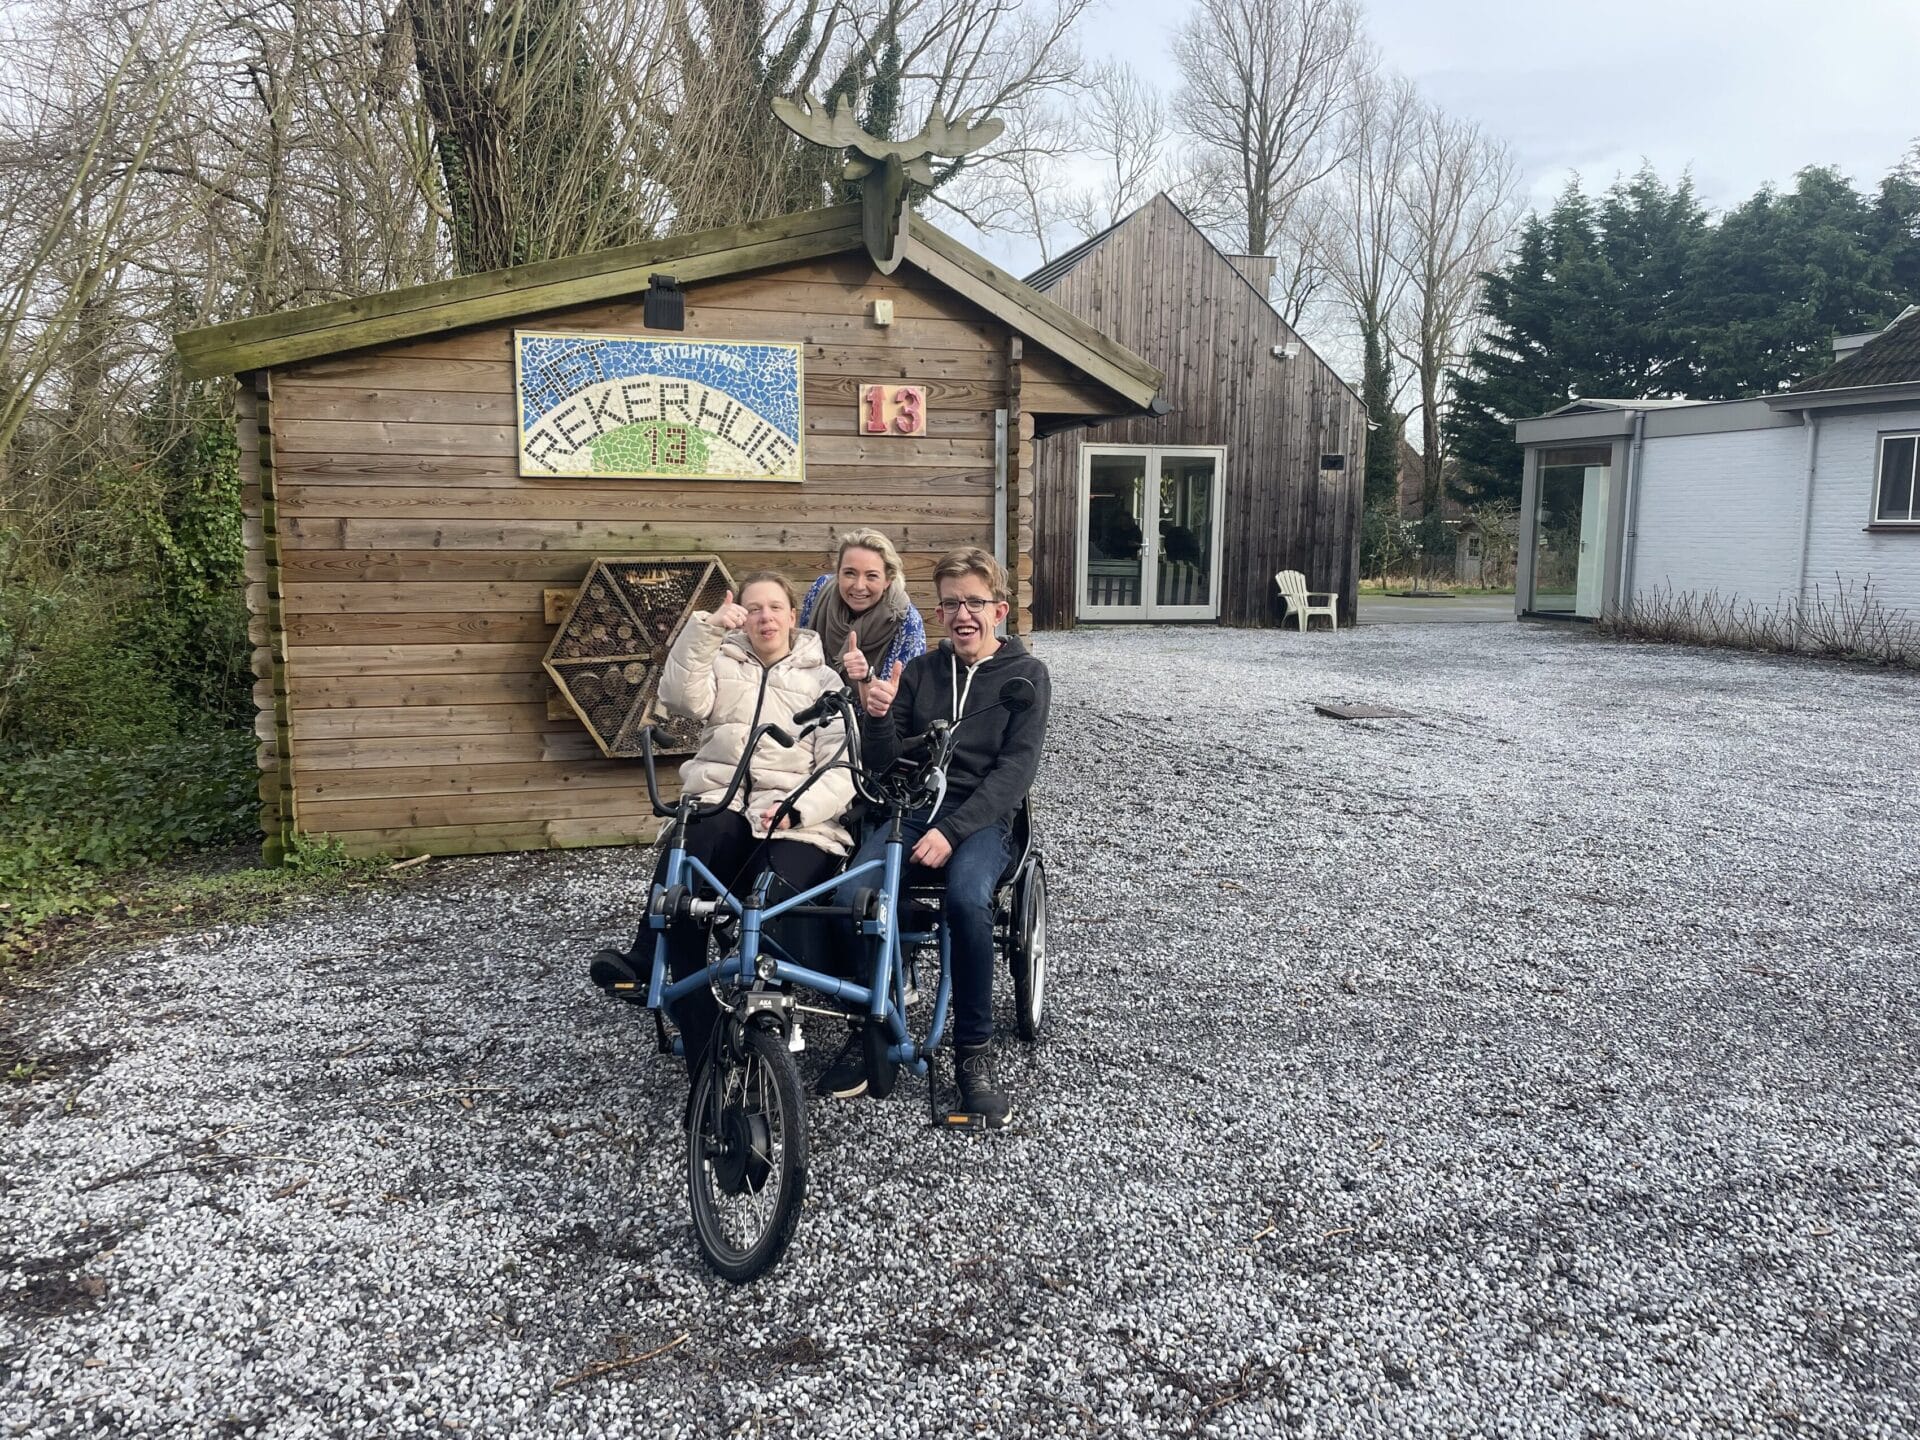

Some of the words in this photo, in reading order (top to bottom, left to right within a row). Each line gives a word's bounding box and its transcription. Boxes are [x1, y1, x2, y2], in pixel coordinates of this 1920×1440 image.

[519, 341, 605, 415] HET
[524, 382, 795, 475] REKERHUIS
[866, 386, 921, 433] 13
[643, 427, 686, 465] 13
